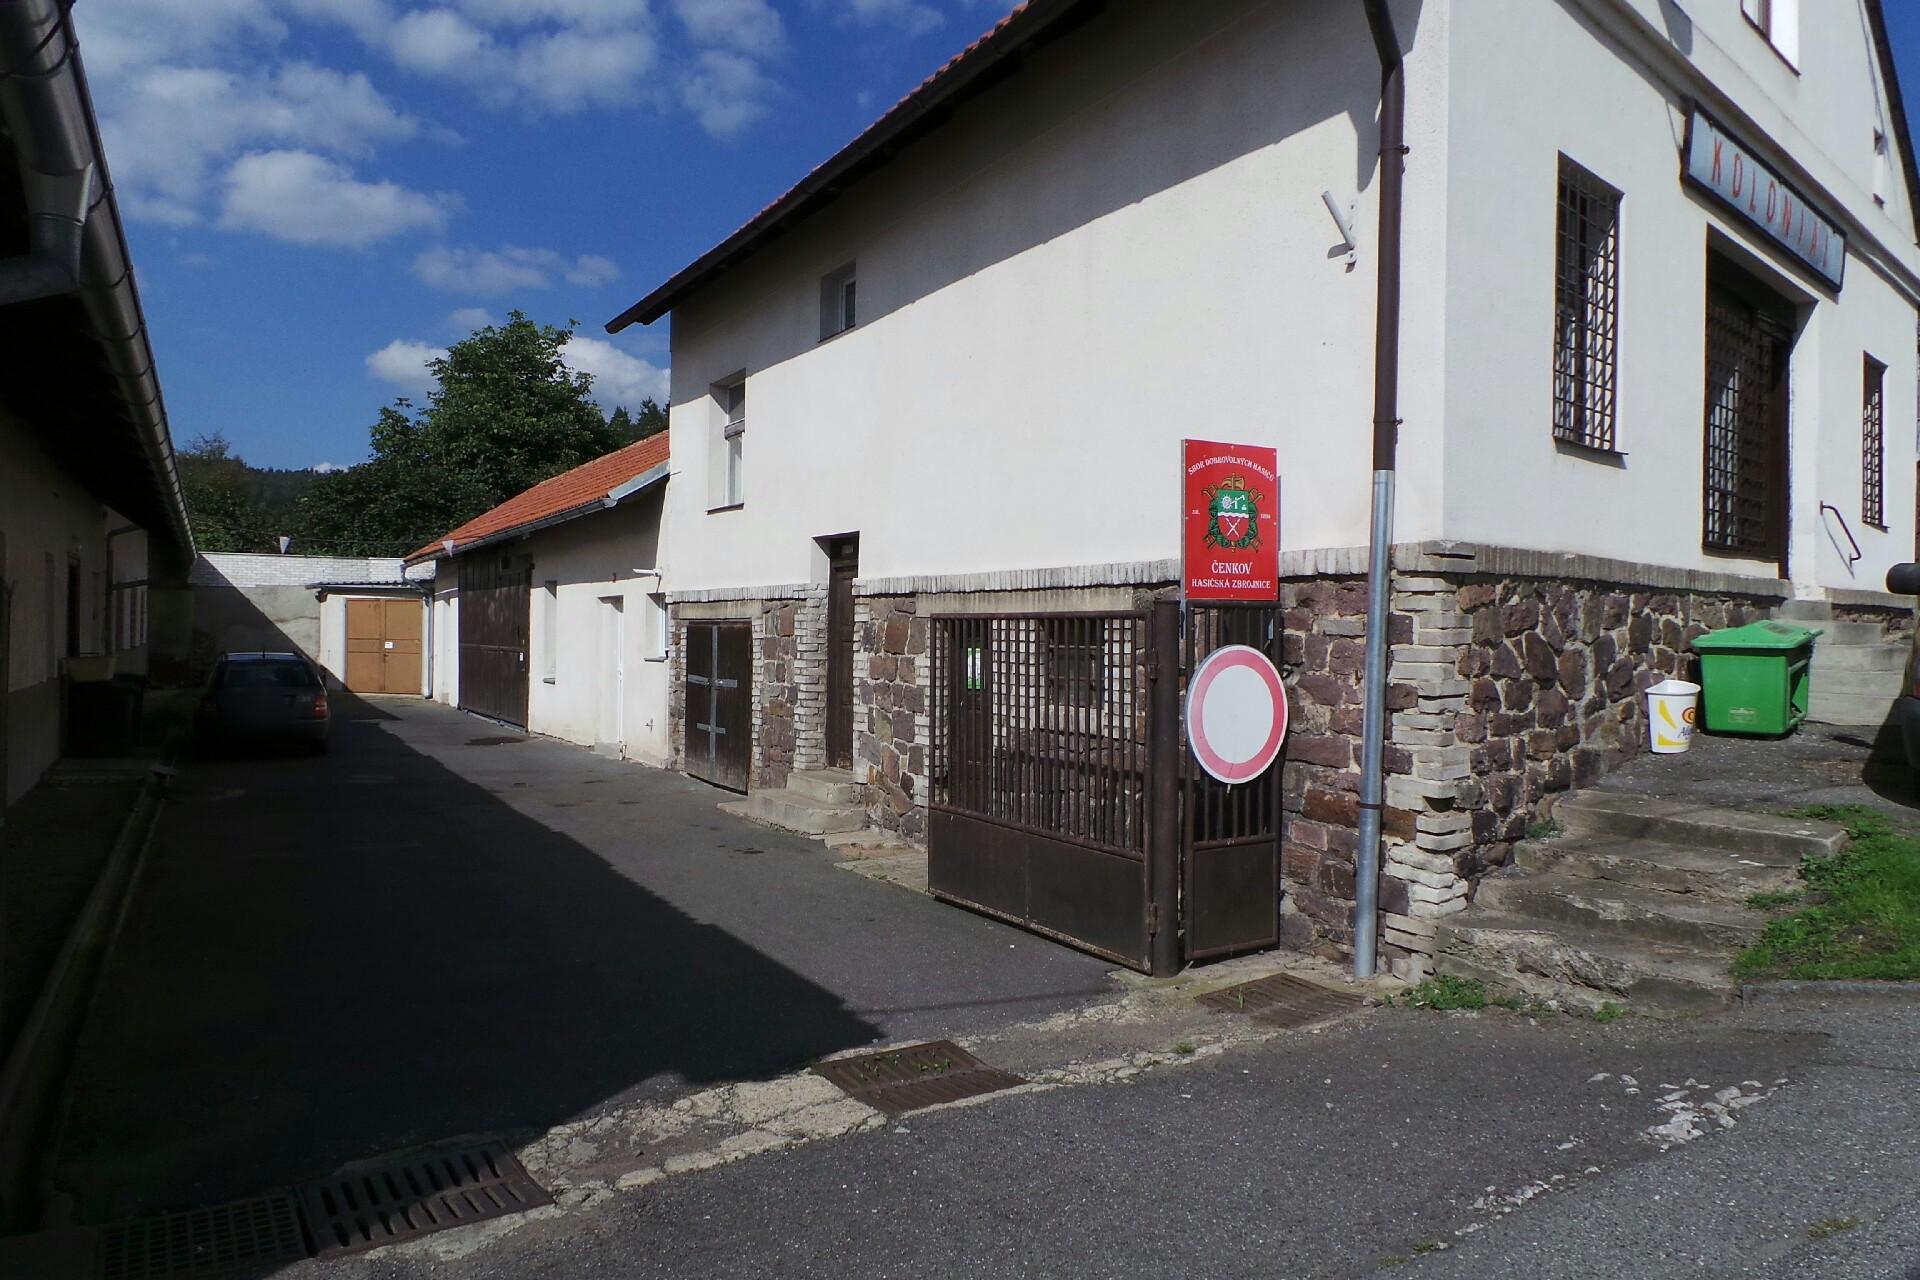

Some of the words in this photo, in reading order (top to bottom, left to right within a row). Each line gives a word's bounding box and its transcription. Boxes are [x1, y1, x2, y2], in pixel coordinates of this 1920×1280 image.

[1711, 134, 1830, 268] KOLONIAL
[1188, 460, 1205, 475] SBOR
[1211, 559, 1252, 574] ČENKOV
[1192, 577, 1230, 588] HASIČSKÁ
[1232, 579, 1271, 589] ZBROJNICE
